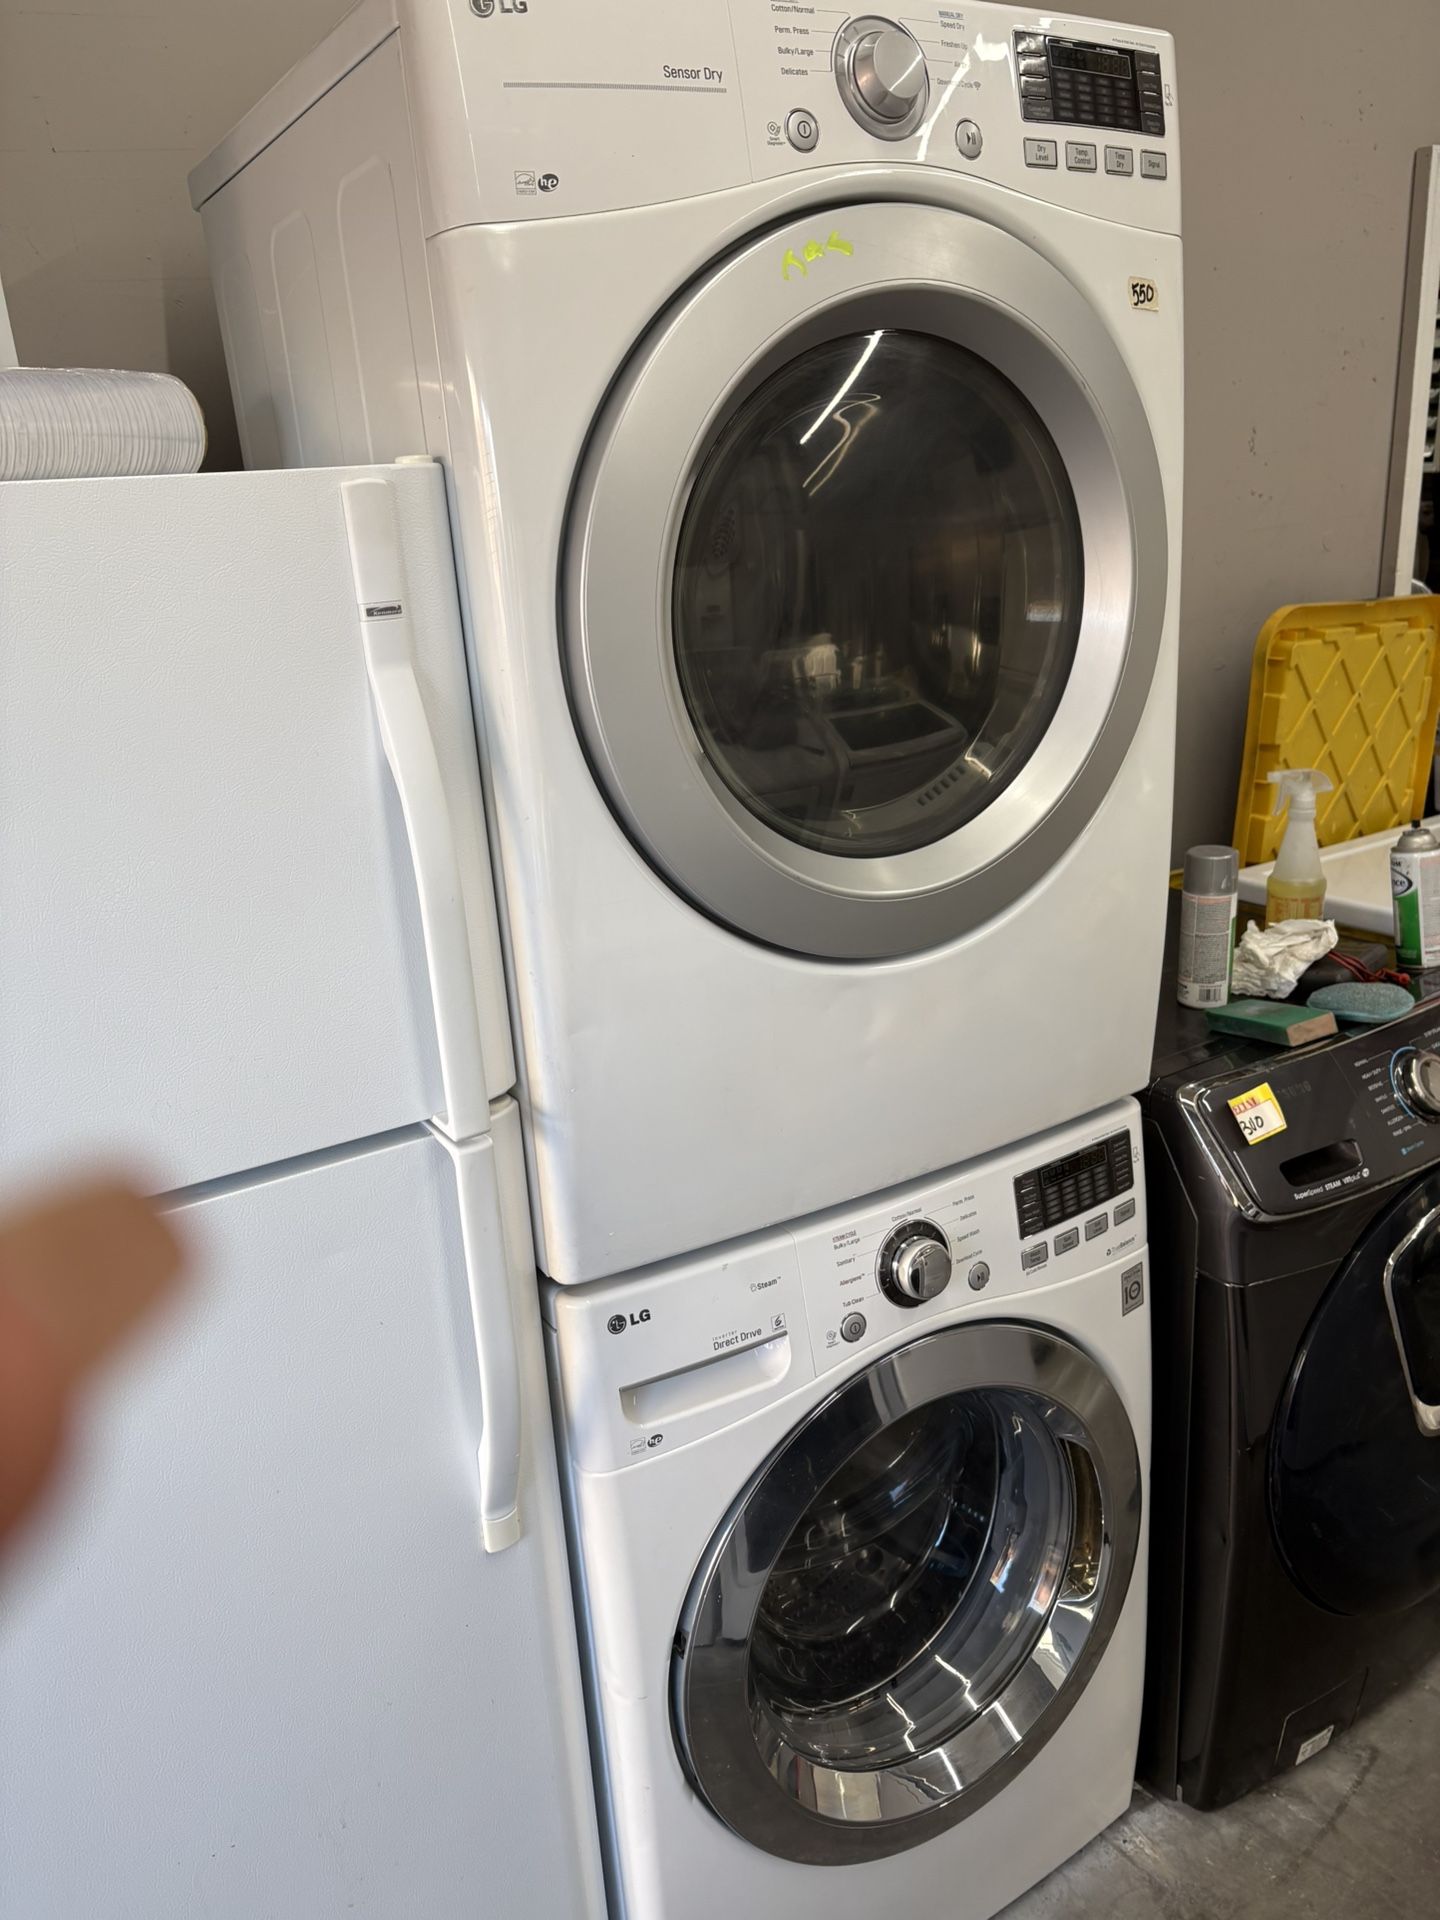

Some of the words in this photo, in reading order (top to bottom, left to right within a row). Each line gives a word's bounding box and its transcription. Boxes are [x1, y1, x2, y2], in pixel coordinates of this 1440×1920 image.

[771, 4, 815, 14] Cotton/Normal
[792, 27, 810, 35] Press
[777, 46, 814, 57] Bulky/Large
[663, 65, 701, 80] Sensor
[703, 67, 723, 83] Dry
[781, 67, 808, 75] Delicates
[1037, 144, 1046, 153] Dry
[1035, 153, 1049, 161] Level
[1074, 157, 1092, 165] Control
[1132, 282, 1154, 306] 550
[629, 1309, 651, 1326] LG
[712, 1329, 738, 1341] inverter
[713, 1335, 740, 1351] Direct
[740, 1328, 763, 1342] Drive
